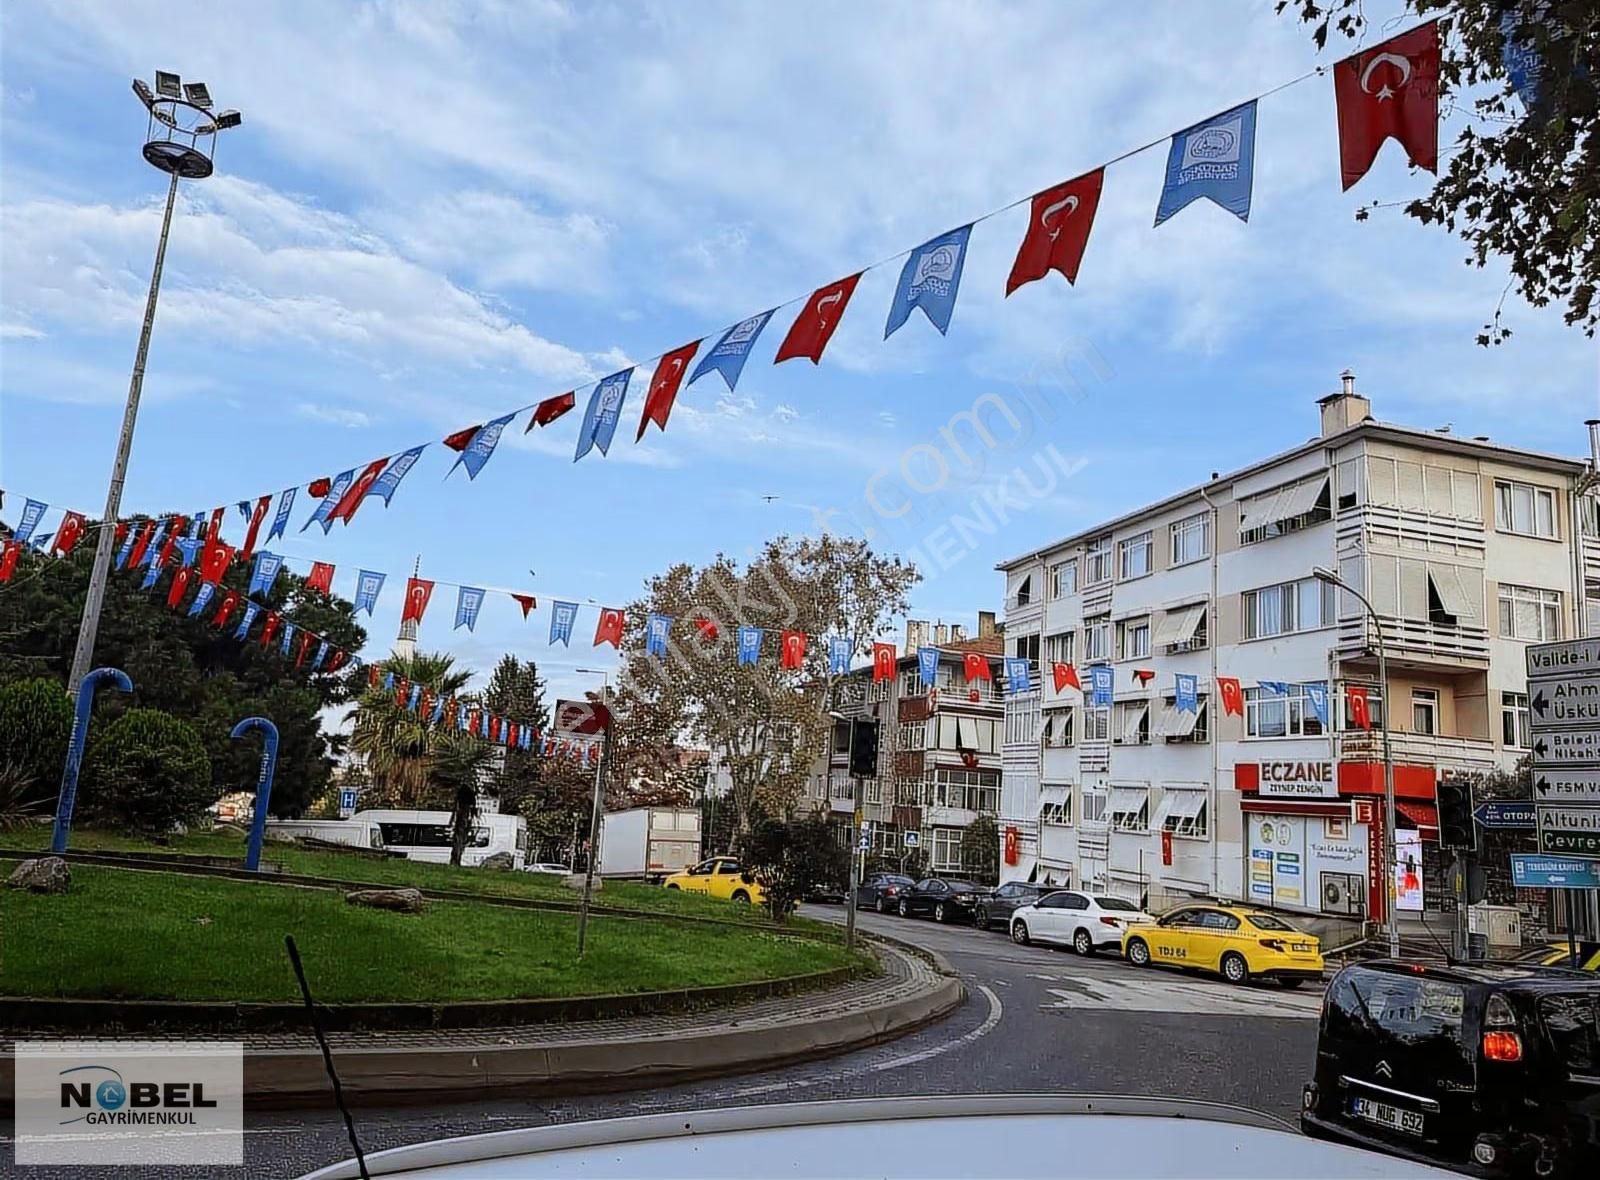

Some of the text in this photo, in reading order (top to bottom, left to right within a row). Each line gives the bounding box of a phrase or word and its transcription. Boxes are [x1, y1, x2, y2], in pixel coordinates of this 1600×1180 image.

[1532, 649, 1589, 668] Valide-i
[1554, 701, 1598, 719] Üskü
[1553, 734, 1600, 745] Beledi
[1261, 763, 1332, 782] ECZANE
[1270, 783, 1295, 793] ZEYNEP
[1556, 782, 1584, 793] FSM
[1543, 812, 1600, 828] Altuni
[1544, 832, 1600, 849] Çevre
[1401, 1111, 1422, 1131] 692
